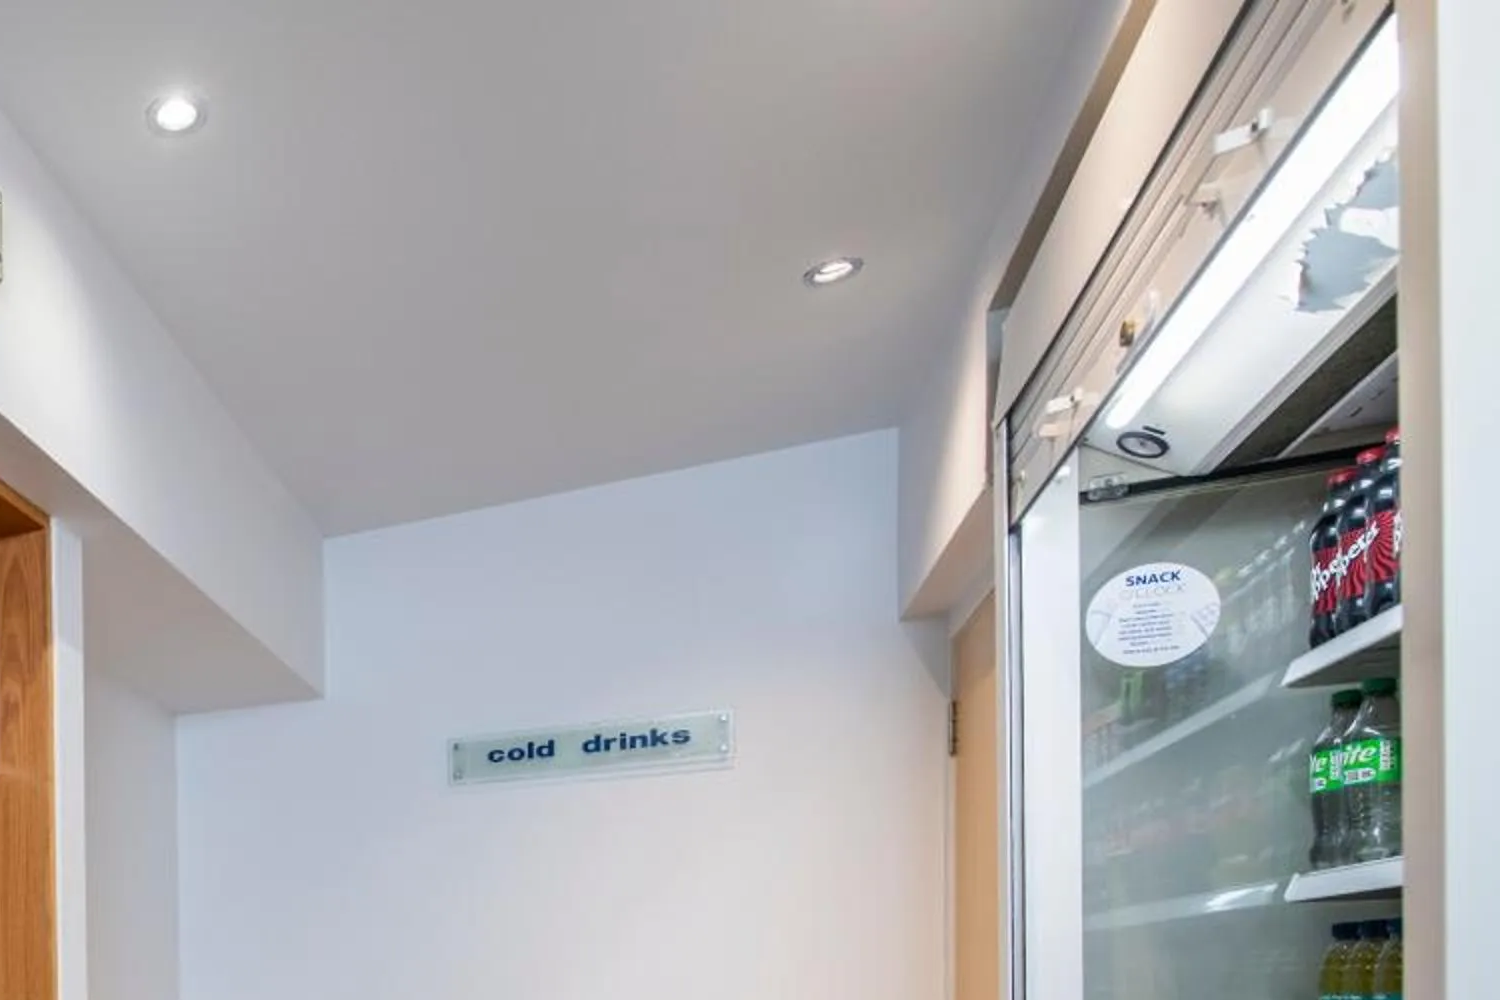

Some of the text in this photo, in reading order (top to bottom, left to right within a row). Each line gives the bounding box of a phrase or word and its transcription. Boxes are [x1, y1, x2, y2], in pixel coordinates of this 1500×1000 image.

[1125, 570, 1182, 588] SNACK
[487, 727, 691, 764] cold drinks
